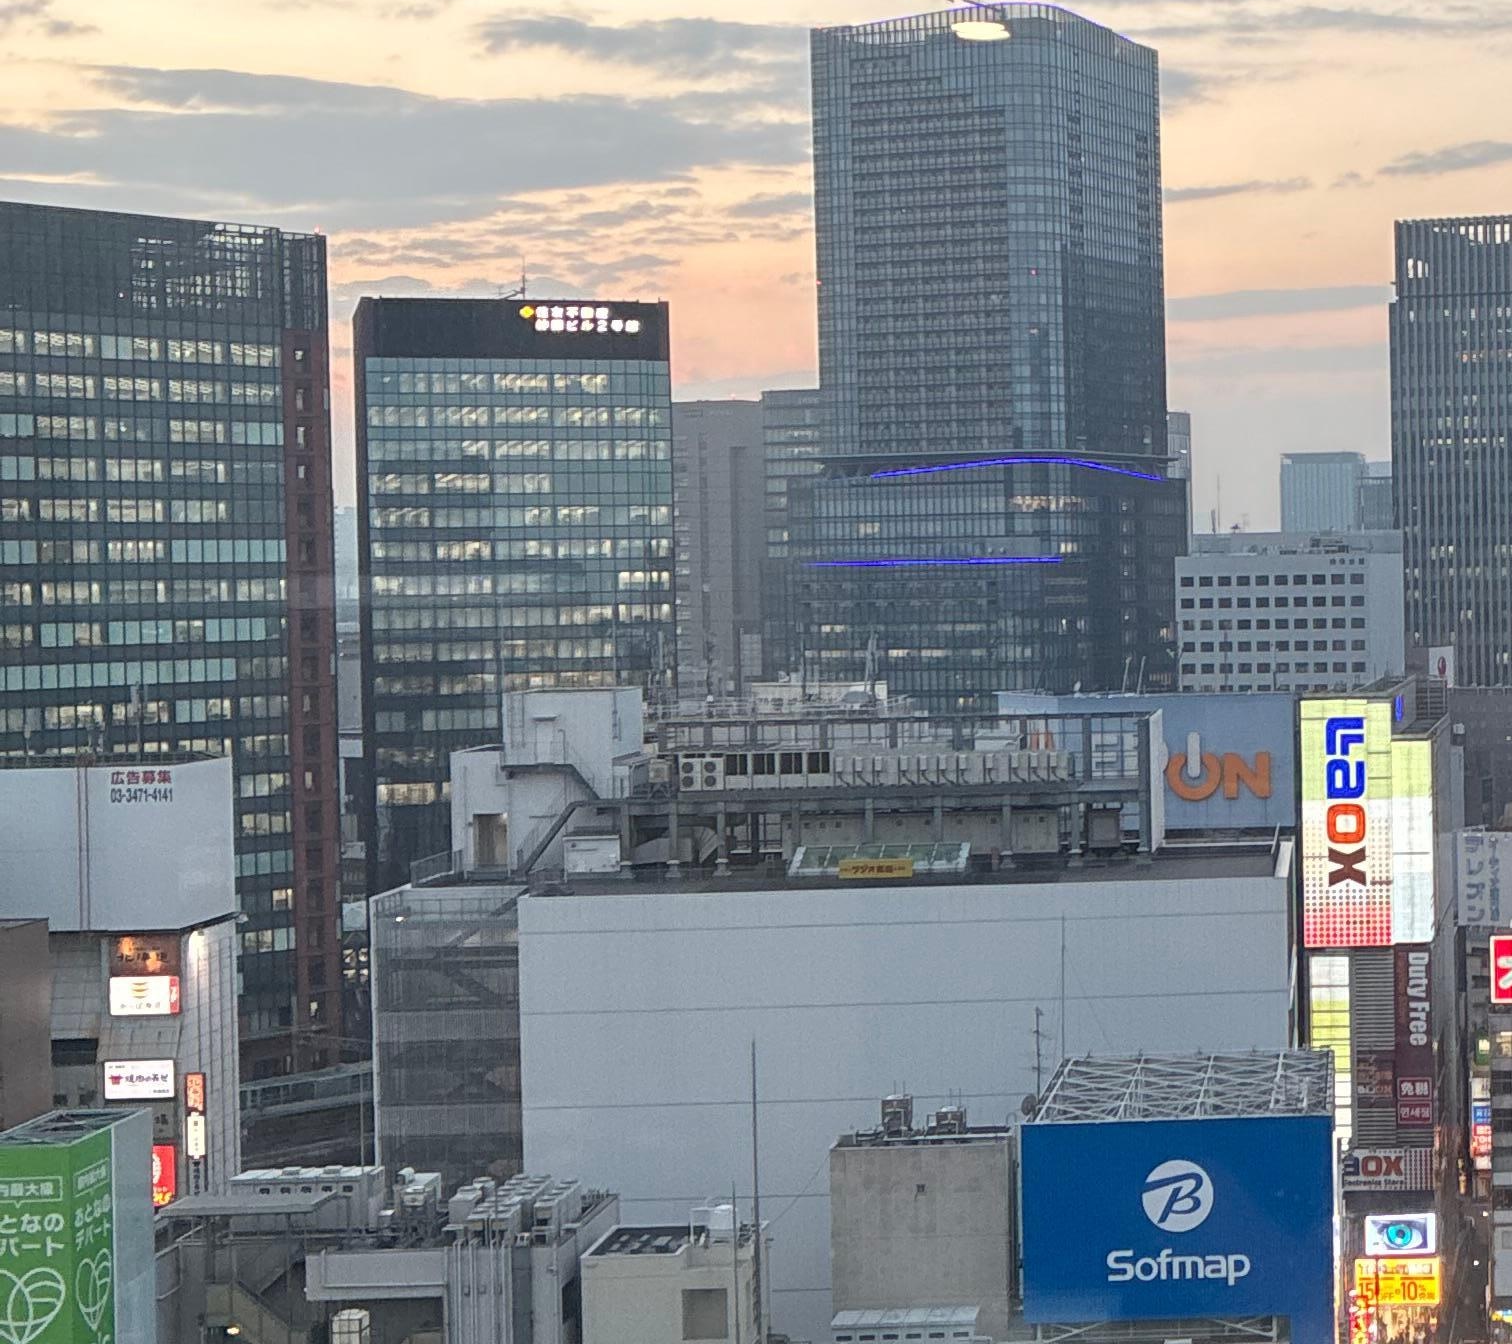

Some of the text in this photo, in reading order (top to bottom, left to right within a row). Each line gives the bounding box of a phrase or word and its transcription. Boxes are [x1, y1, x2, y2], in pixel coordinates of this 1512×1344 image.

[110, 769, 172, 785] 広告募集
[1406, 952, 1430, 1046] Duty Free
[1106, 1248, 1251, 1286] Sofmap
